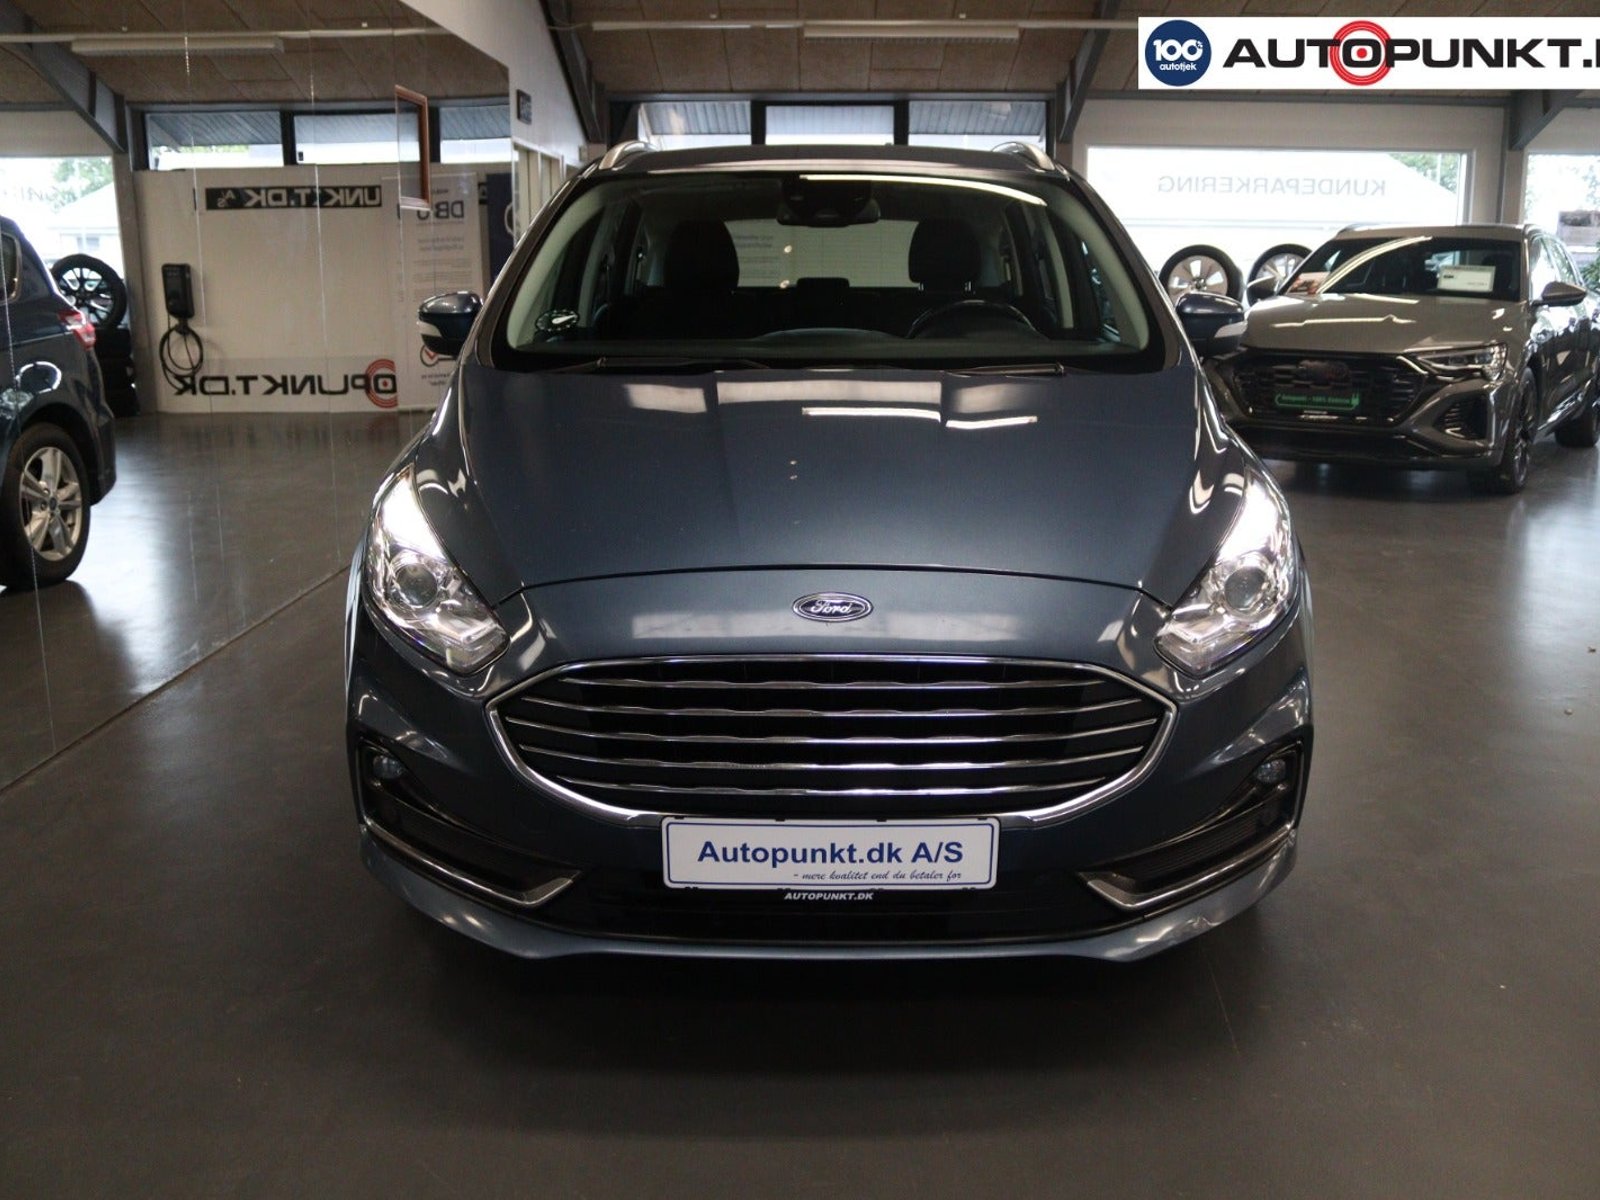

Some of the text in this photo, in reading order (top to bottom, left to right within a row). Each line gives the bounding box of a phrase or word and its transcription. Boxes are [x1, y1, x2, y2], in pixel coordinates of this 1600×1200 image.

[811, 600, 853, 614] Ford
[697, 841, 964, 868] Autopunkt.dk A/S
[871, 871, 889, 880] end
[892, 870, 906, 879] du
[909, 870, 944, 880] betaler
[946, 870, 962, 882] for
[784, 892, 874, 900] AUTOPUNKT.DK
